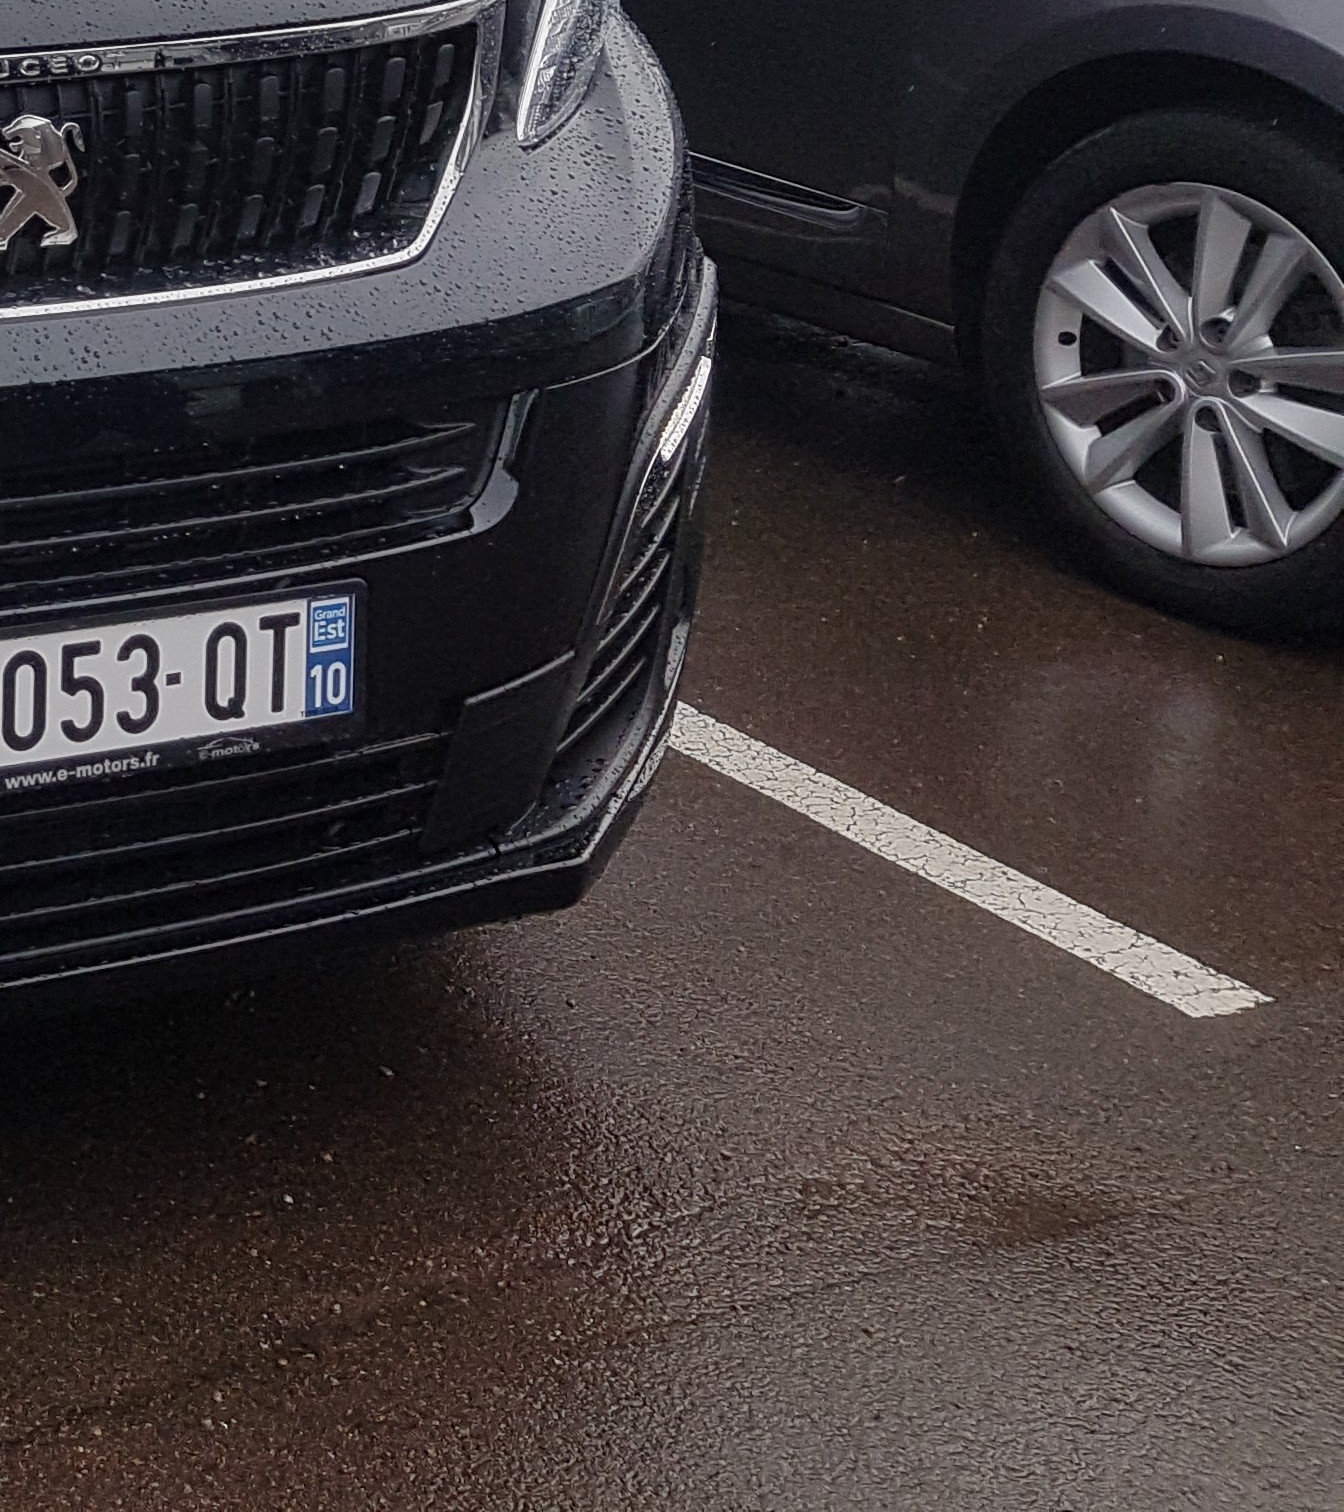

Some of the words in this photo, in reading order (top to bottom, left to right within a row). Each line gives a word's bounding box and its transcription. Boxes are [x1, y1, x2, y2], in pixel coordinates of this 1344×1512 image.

[314, 605, 346, 620] Grand
[313, 618, 345, 641] Est
[310, 660, 347, 708] 10
[4, 751, 160, 790] www.e-motors.fr
